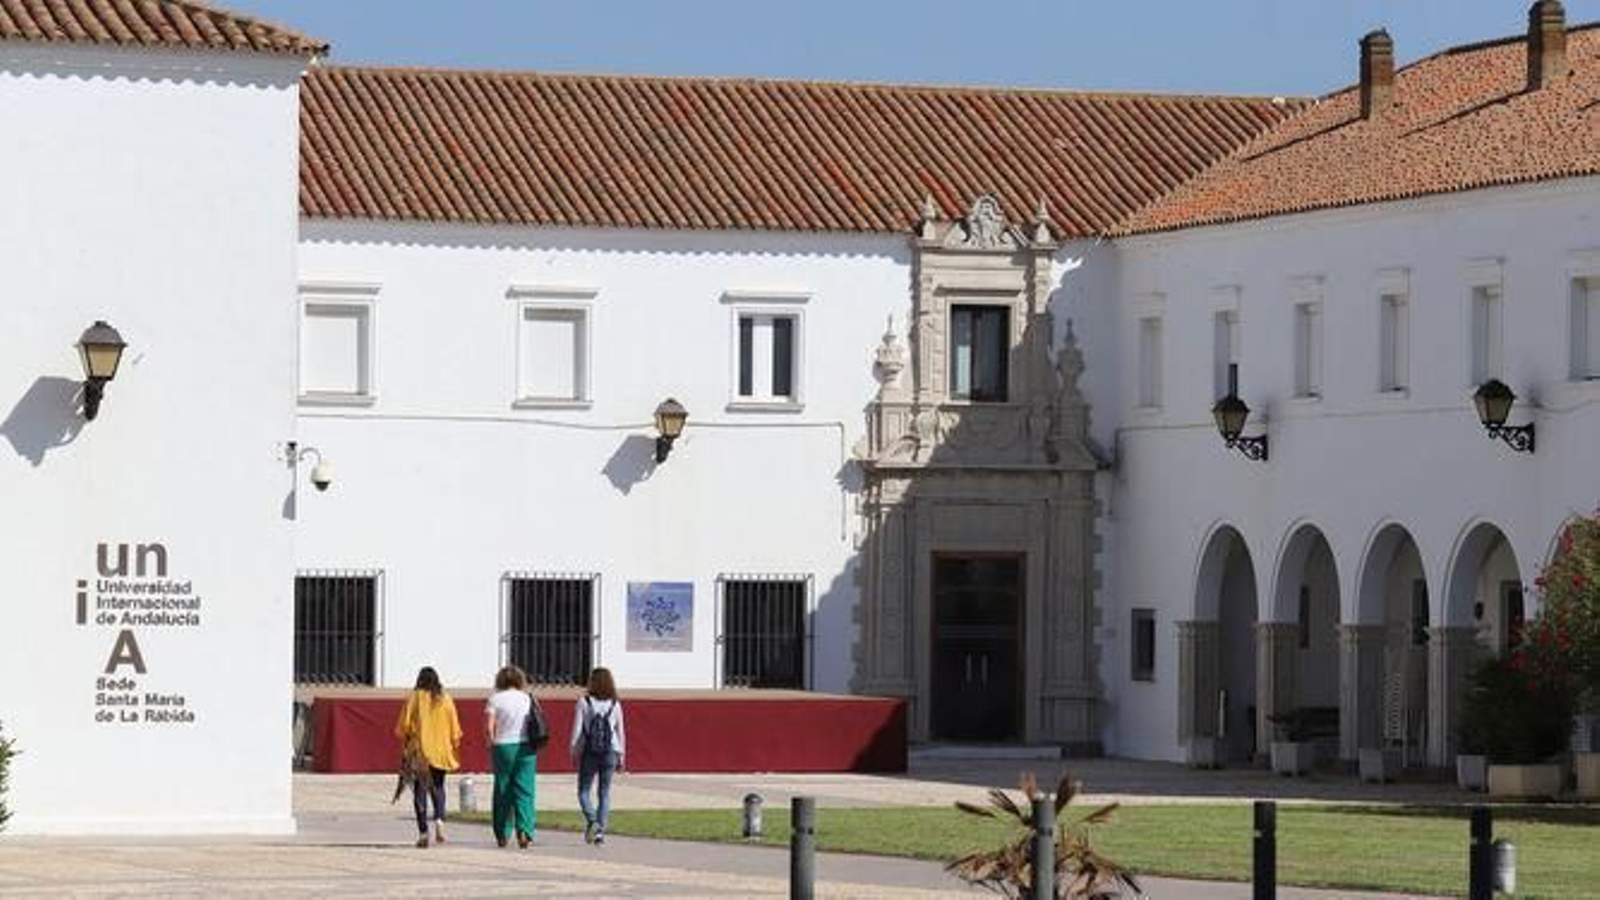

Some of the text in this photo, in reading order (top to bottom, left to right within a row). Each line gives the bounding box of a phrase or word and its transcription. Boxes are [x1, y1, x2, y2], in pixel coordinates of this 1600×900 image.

[97, 543, 167, 577] un
[97, 580, 192, 594] Universidad
[76, 580, 88, 625] i
[97, 596, 201, 610] Internacional
[96, 612, 117, 625] de
[105, 629, 147, 674] A
[96, 678, 137, 691] Sede
[96, 693, 139, 706] Santa
[96, 709, 115, 722] de
[120, 709, 139, 722] La
